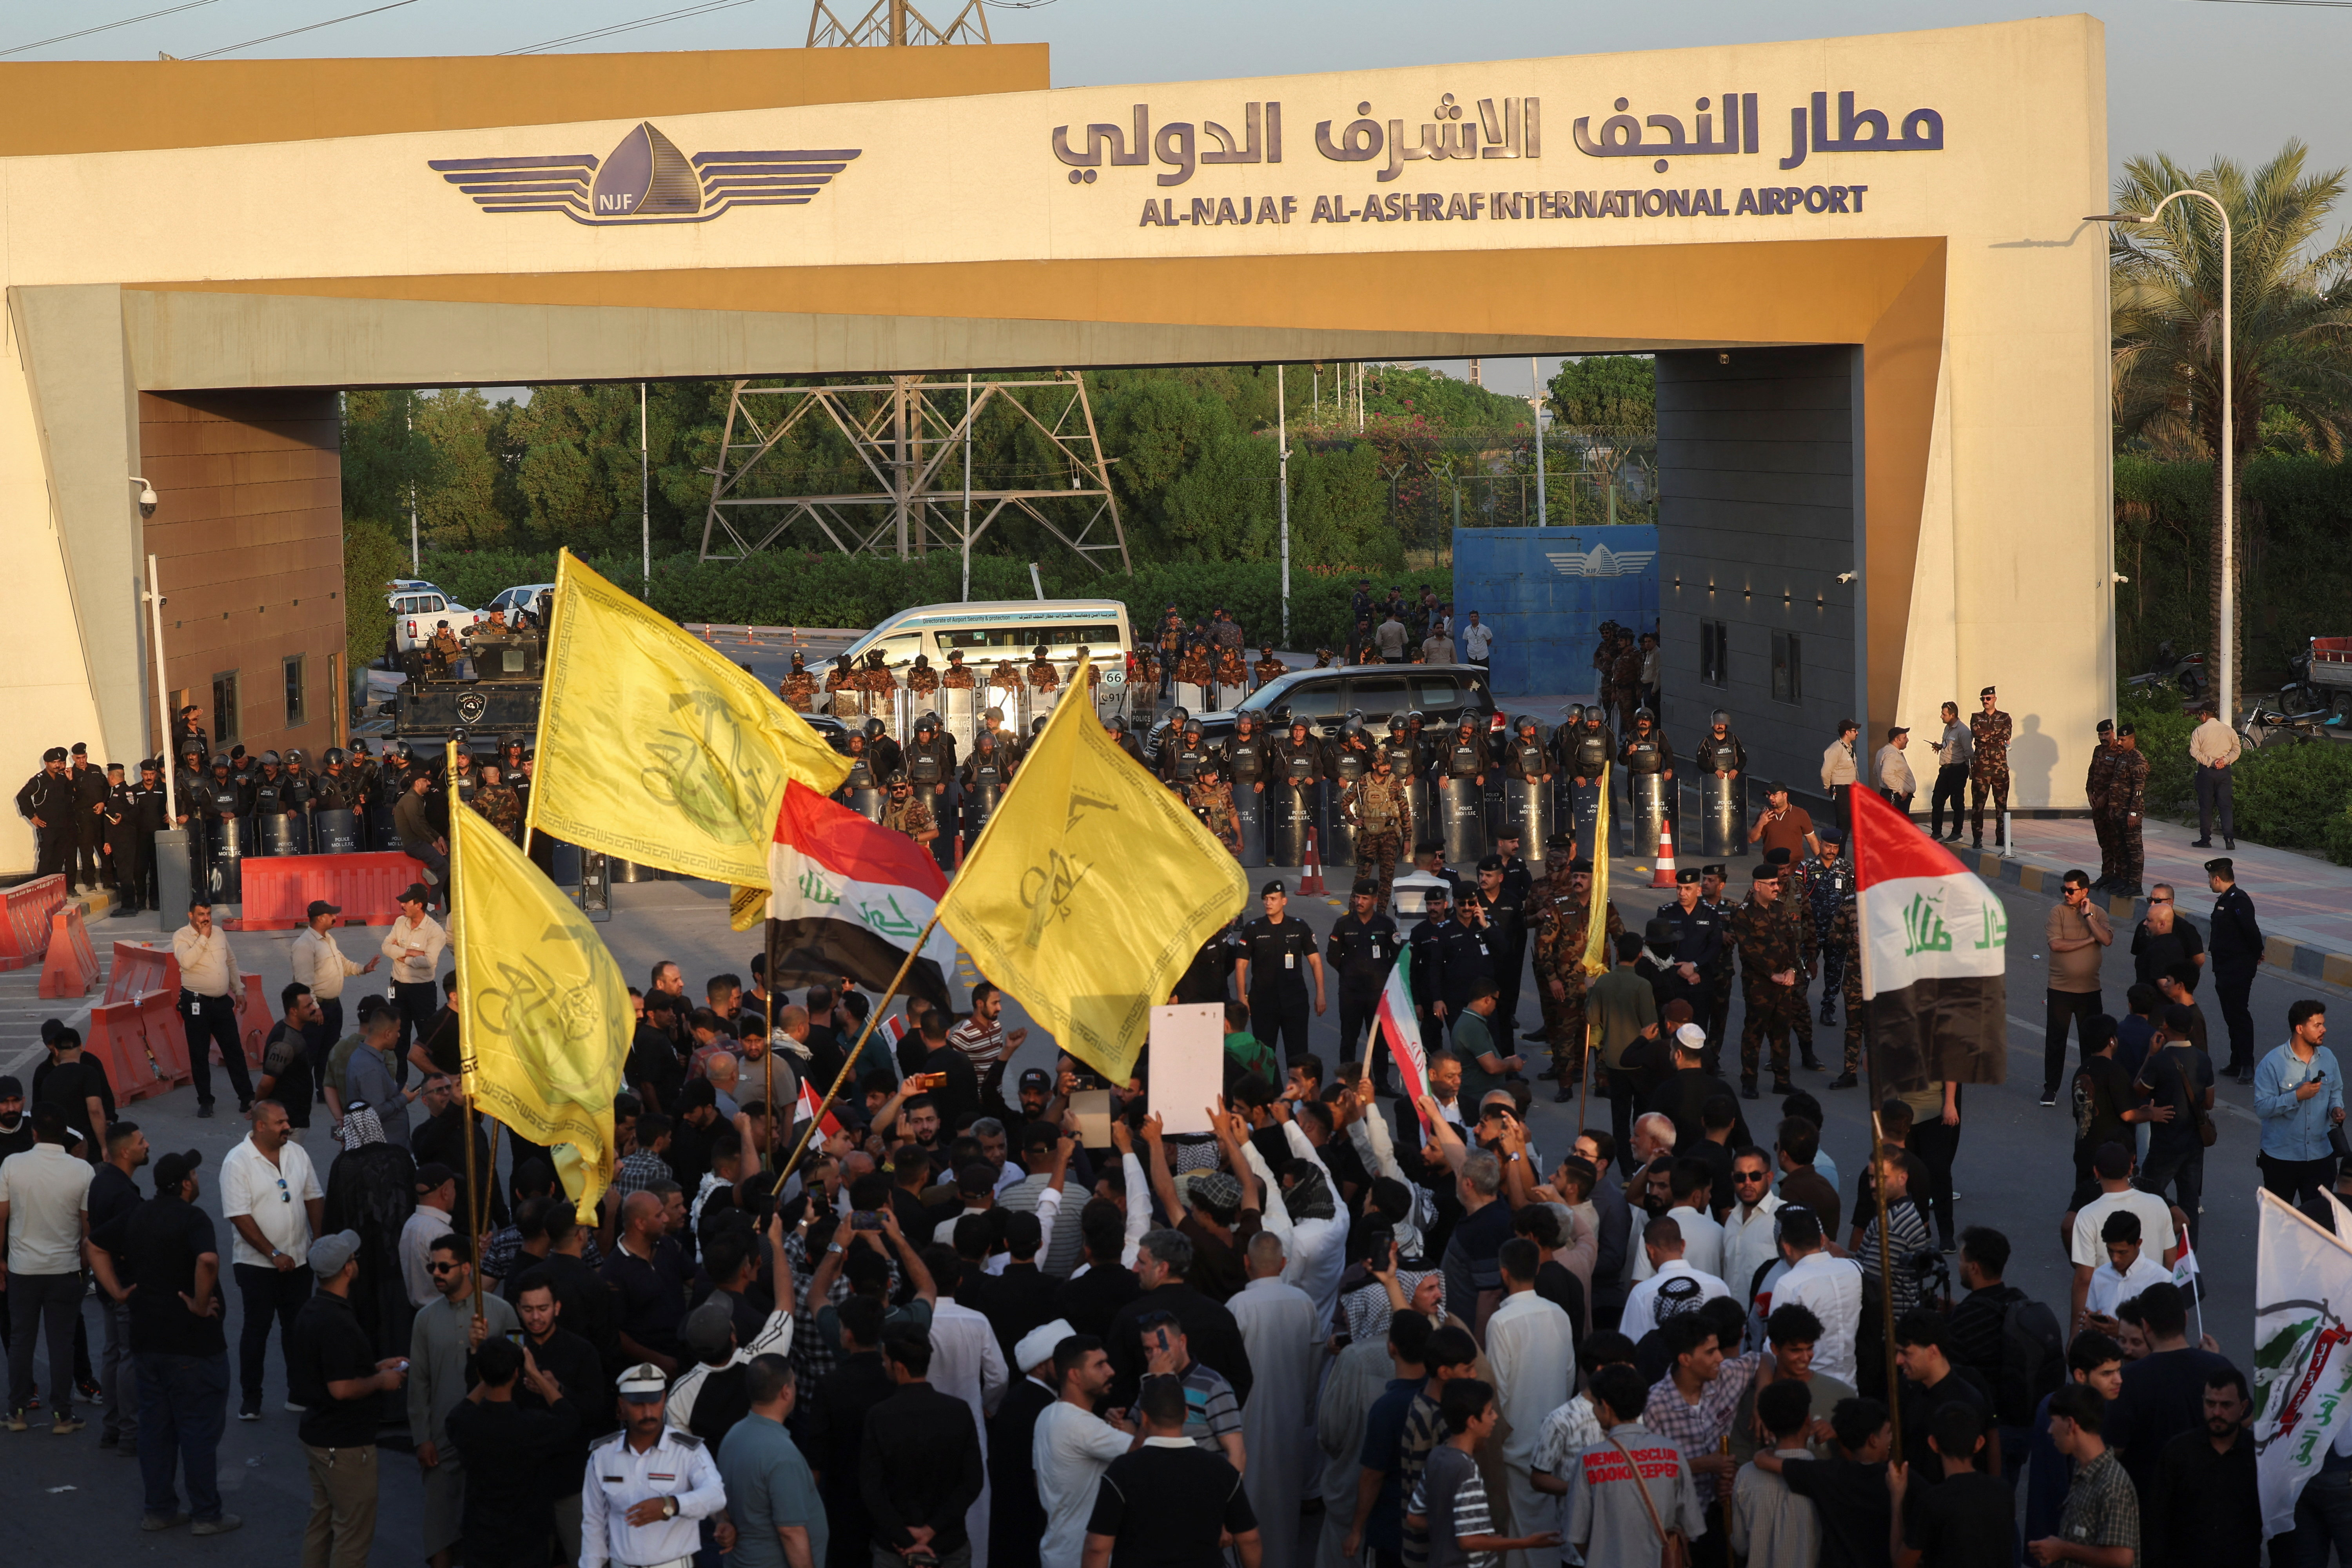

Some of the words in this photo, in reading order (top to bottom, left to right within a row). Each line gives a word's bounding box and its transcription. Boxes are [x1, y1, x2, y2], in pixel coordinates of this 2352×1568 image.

[1052, 102, 1281, 186] الدولي
[1315, 93, 1541, 182] الاشرف
[1573, 93, 1759, 174] النجف
[1779, 90, 1944, 170] مطار
[599, 194, 632, 211] NJF
[1139, 195, 1298, 227] AL-NAJAF
[1310, 192, 1485, 223] AL-ASHRAF
[1490, 189, 1730, 220] INTERNATIONAL
[1734, 185, 1868, 216] AIRPORT
[1107, 673, 1122, 682] 66
[211, 867, 222, 892] 10
[2290, 1430, 2321, 1467] الحق
